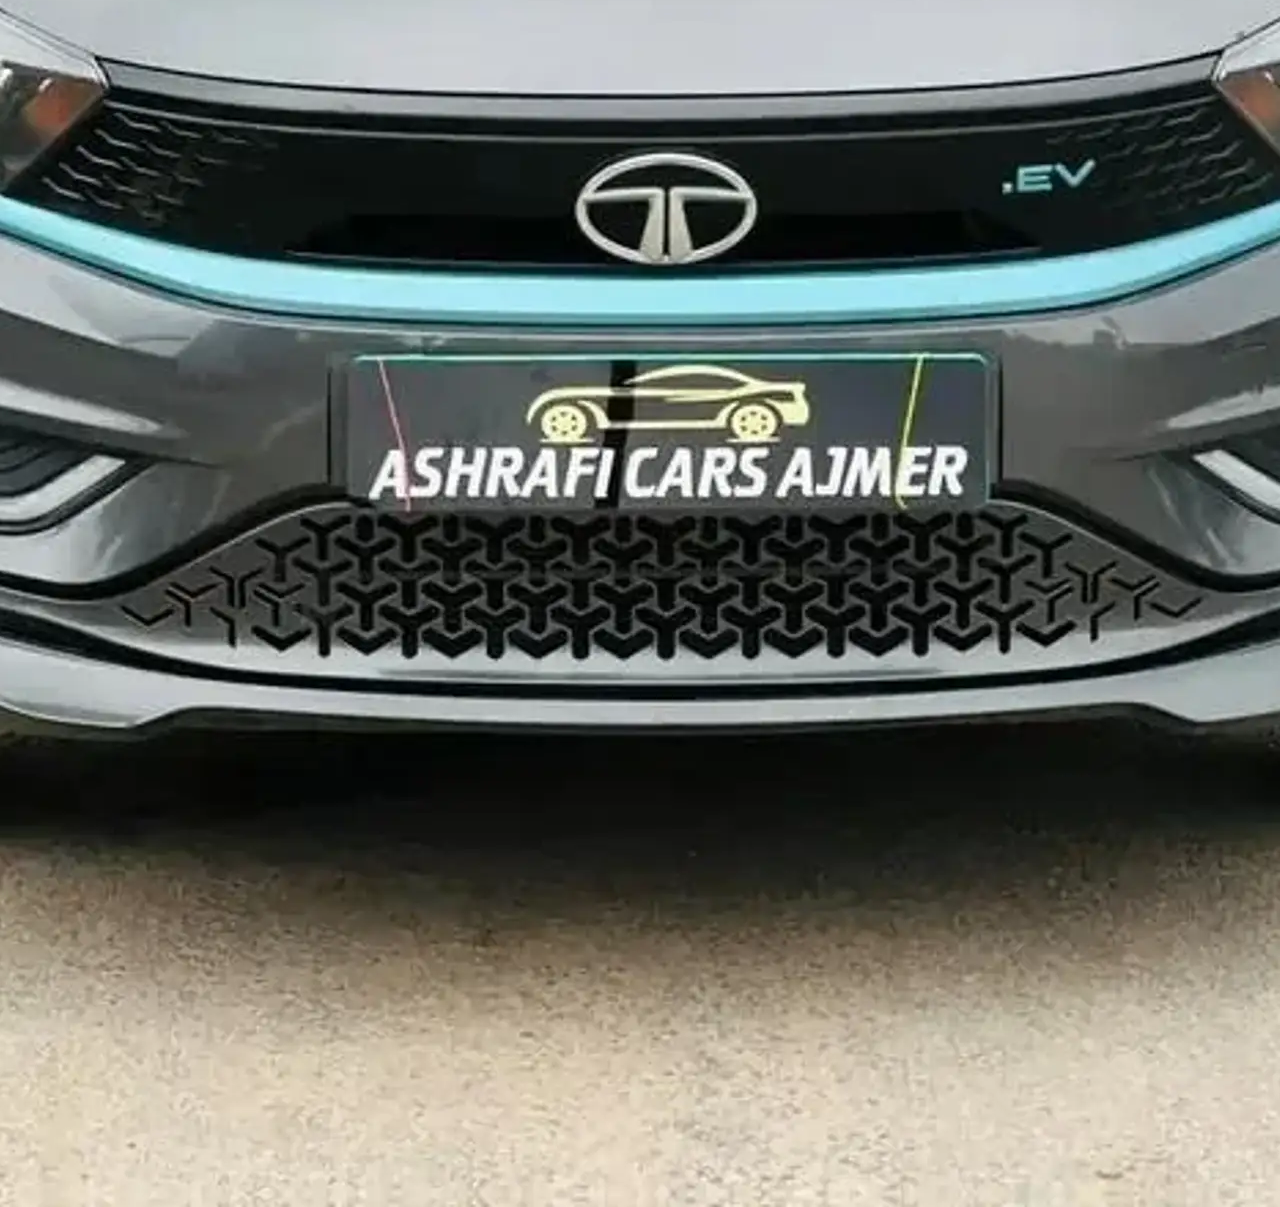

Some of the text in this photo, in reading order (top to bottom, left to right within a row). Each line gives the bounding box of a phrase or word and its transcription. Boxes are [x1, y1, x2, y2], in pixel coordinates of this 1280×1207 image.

[369, 446, 968, 500] ASHRAFI CARS AJMER
